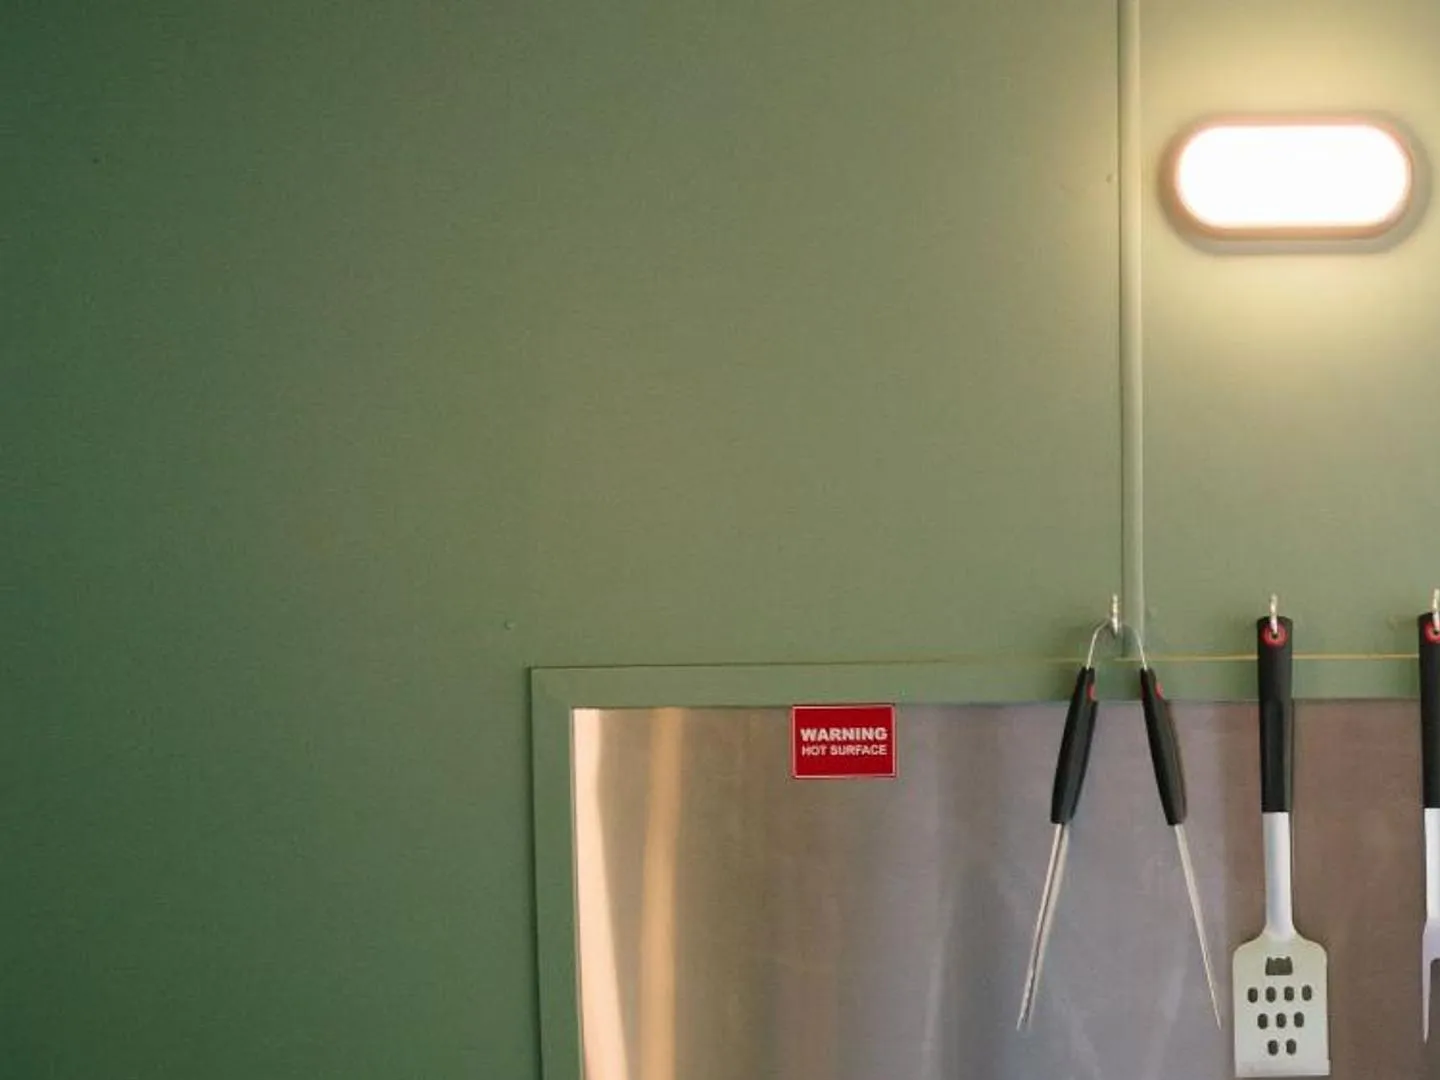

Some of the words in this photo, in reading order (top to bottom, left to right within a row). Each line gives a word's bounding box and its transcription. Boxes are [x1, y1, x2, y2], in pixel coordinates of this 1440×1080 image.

[800, 727, 888, 742] WARNING
[802, 744, 827, 756] HOT
[830, 743, 888, 756] SURFACE
